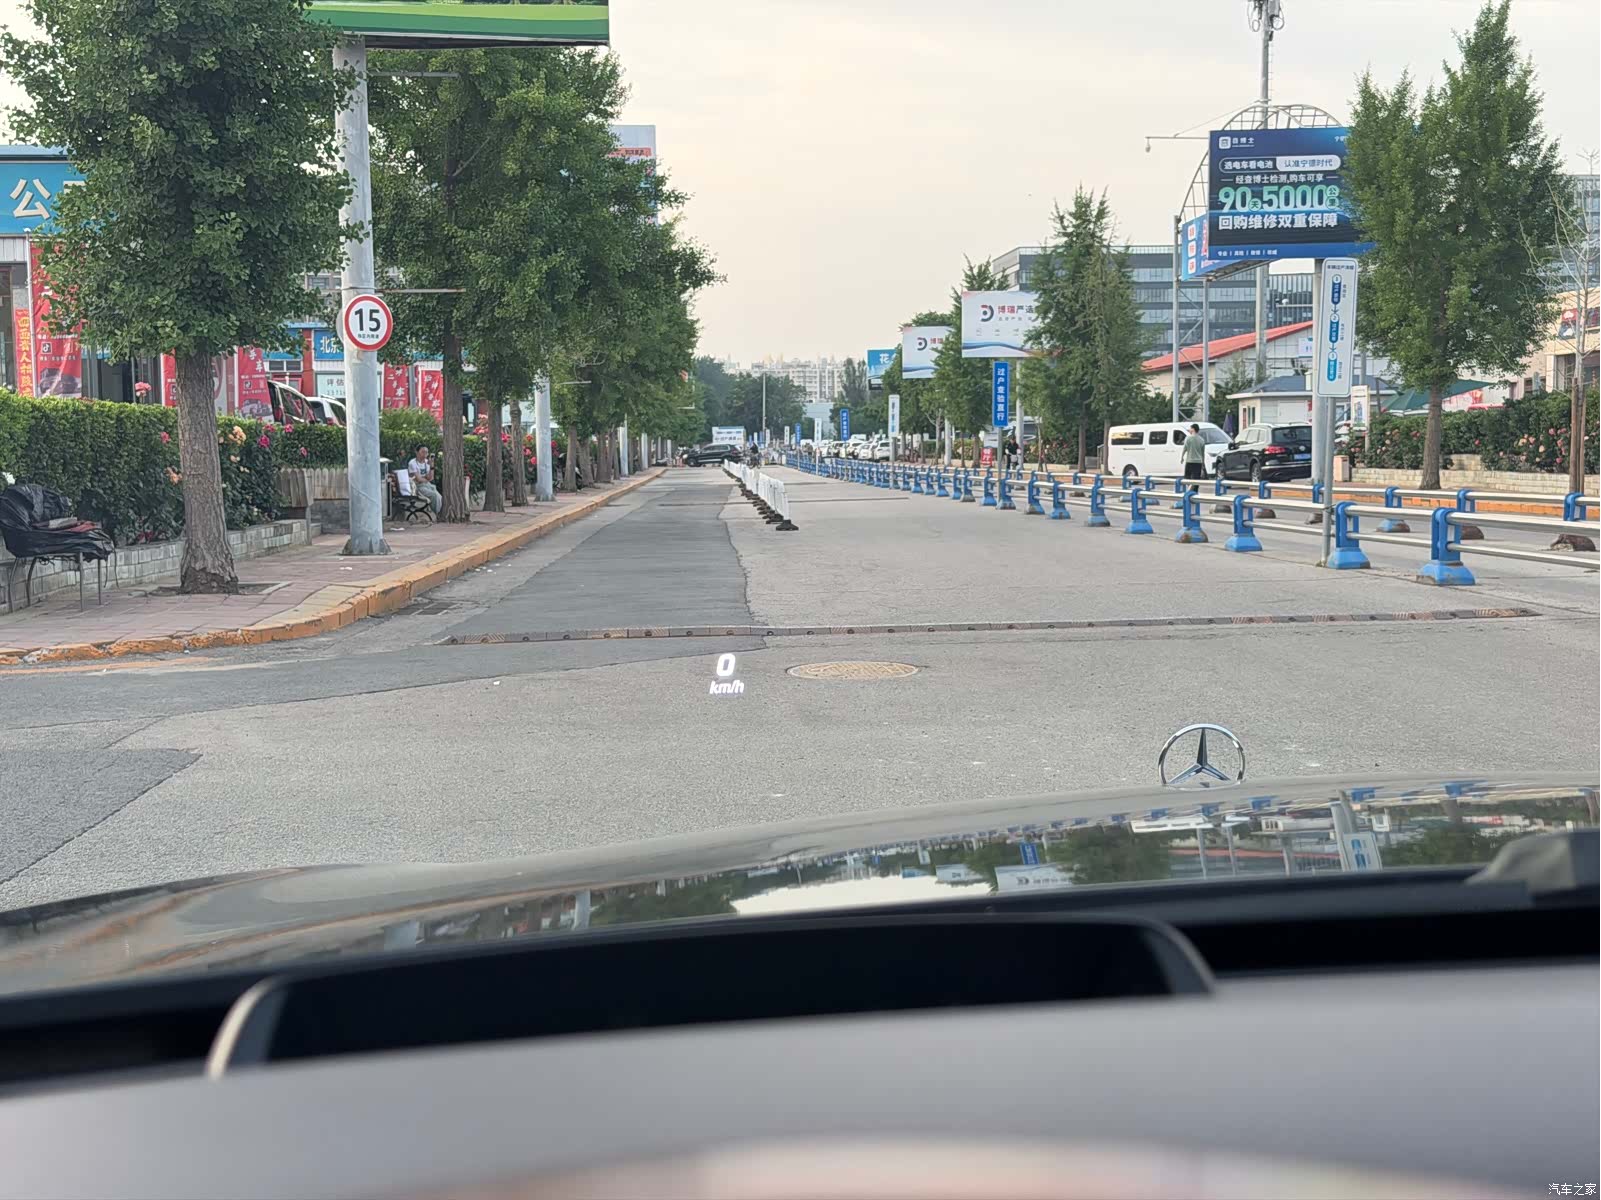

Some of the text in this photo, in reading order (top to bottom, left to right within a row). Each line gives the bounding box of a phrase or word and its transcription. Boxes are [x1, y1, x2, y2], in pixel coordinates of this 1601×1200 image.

[1223, 158, 1333, 170] 选电车看电池 认准宁德时代
[1235, 173, 1324, 184] 经查博士检测,购车可享
[1218, 212, 1338, 230] 回购维修双重保障
[354, 308, 381, 332] 15
[716, 653, 736, 676] 0
[709, 680, 745, 695] km/h
